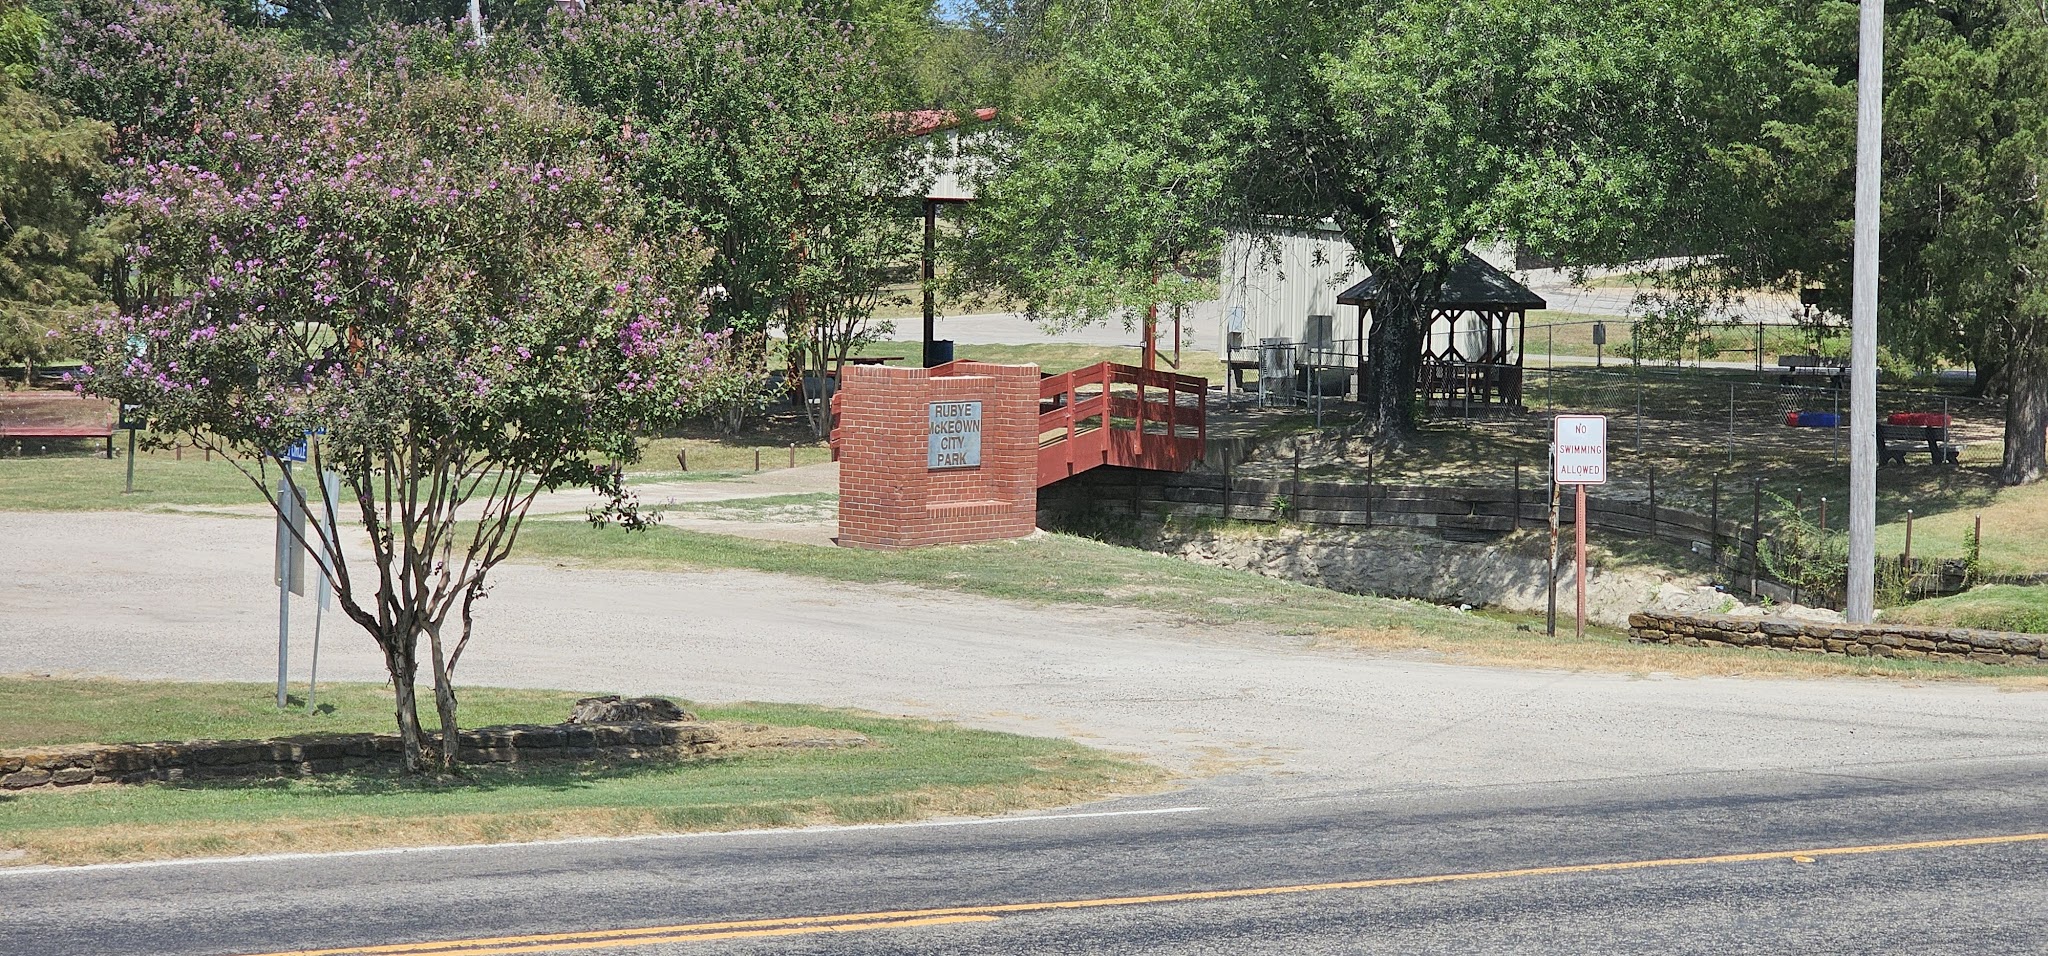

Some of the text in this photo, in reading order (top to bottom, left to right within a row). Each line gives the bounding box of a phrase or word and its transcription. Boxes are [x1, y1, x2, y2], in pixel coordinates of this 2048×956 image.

[935, 404, 972, 417] RUBYE
[929, 420, 980, 434] McKEOWN
[1575, 425, 1587, 434] NO
[941, 436, 965, 450] CITY
[1560, 445, 1602, 454] SWIMMING
[937, 452, 967, 466] PARK
[1561, 465, 1600, 475] ALLOWED
